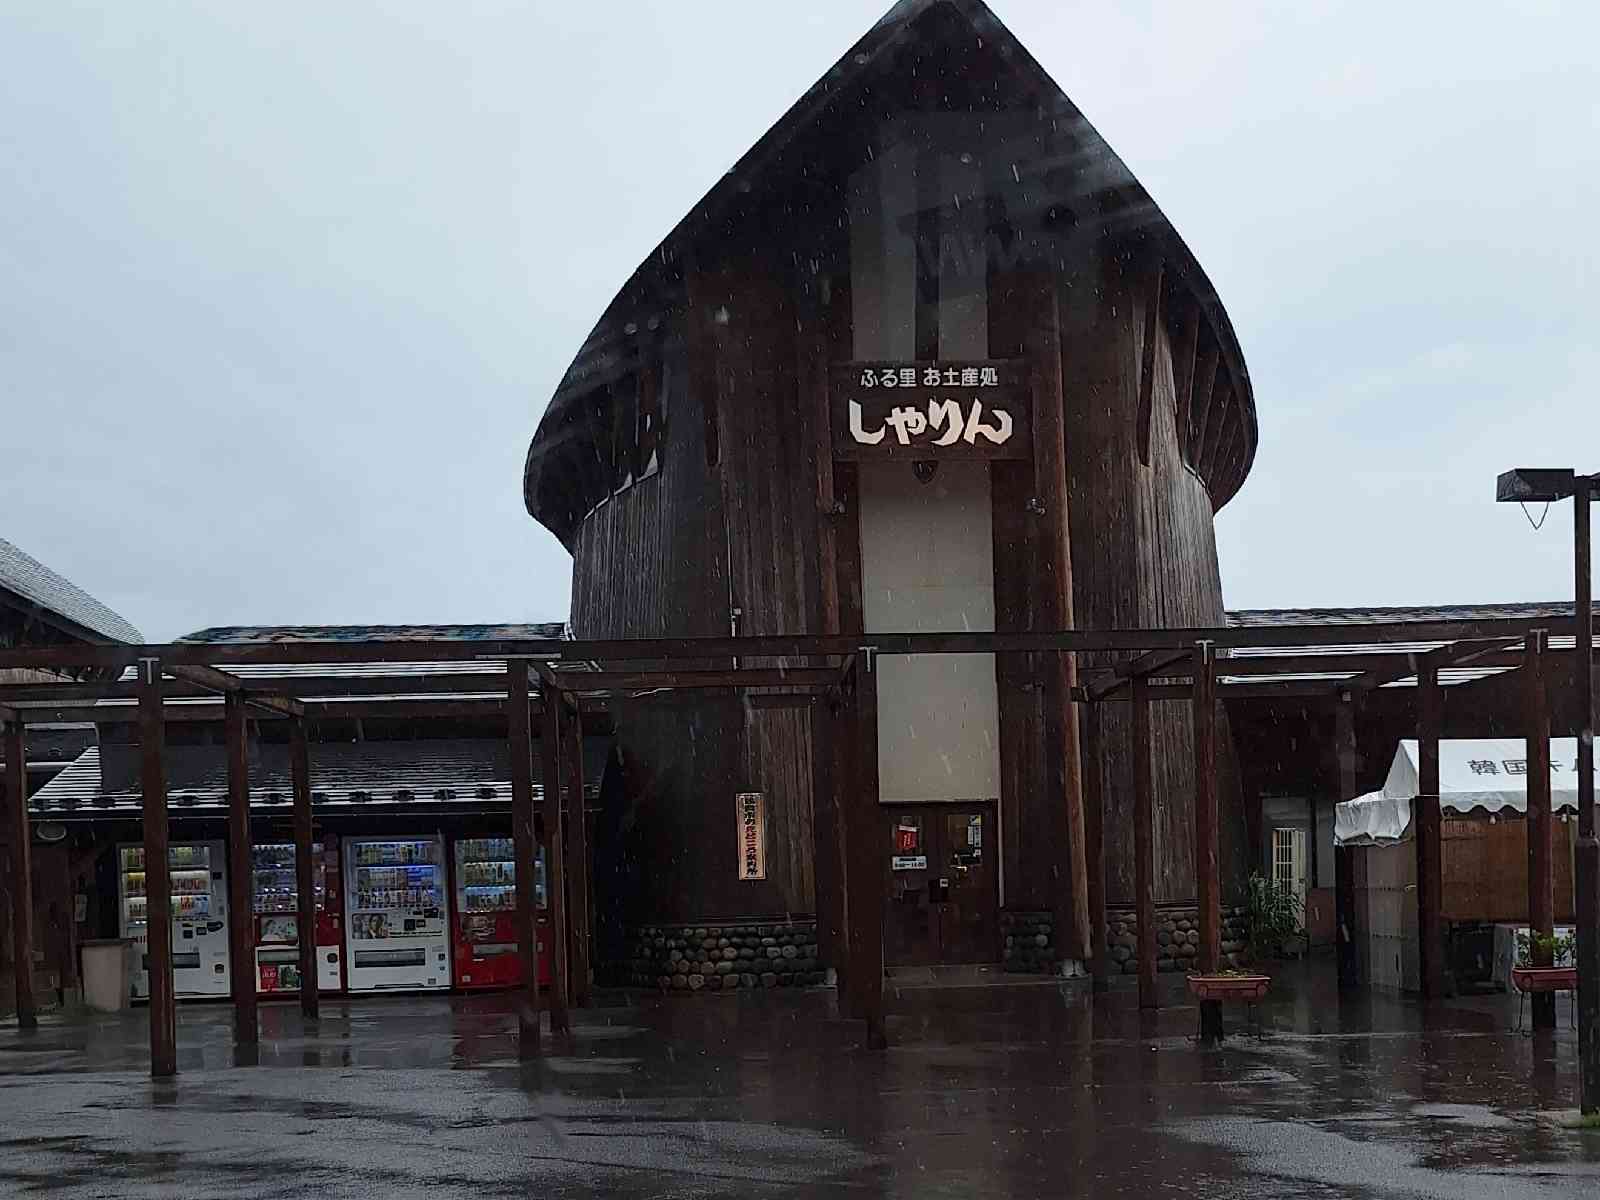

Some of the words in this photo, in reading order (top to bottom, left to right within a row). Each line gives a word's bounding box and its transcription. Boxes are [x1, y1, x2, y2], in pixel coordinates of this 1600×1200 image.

[861, 368, 917, 387] ふる里
[923, 367, 999, 387] お土産処
[849, 398, 1013, 446] しゃりん
